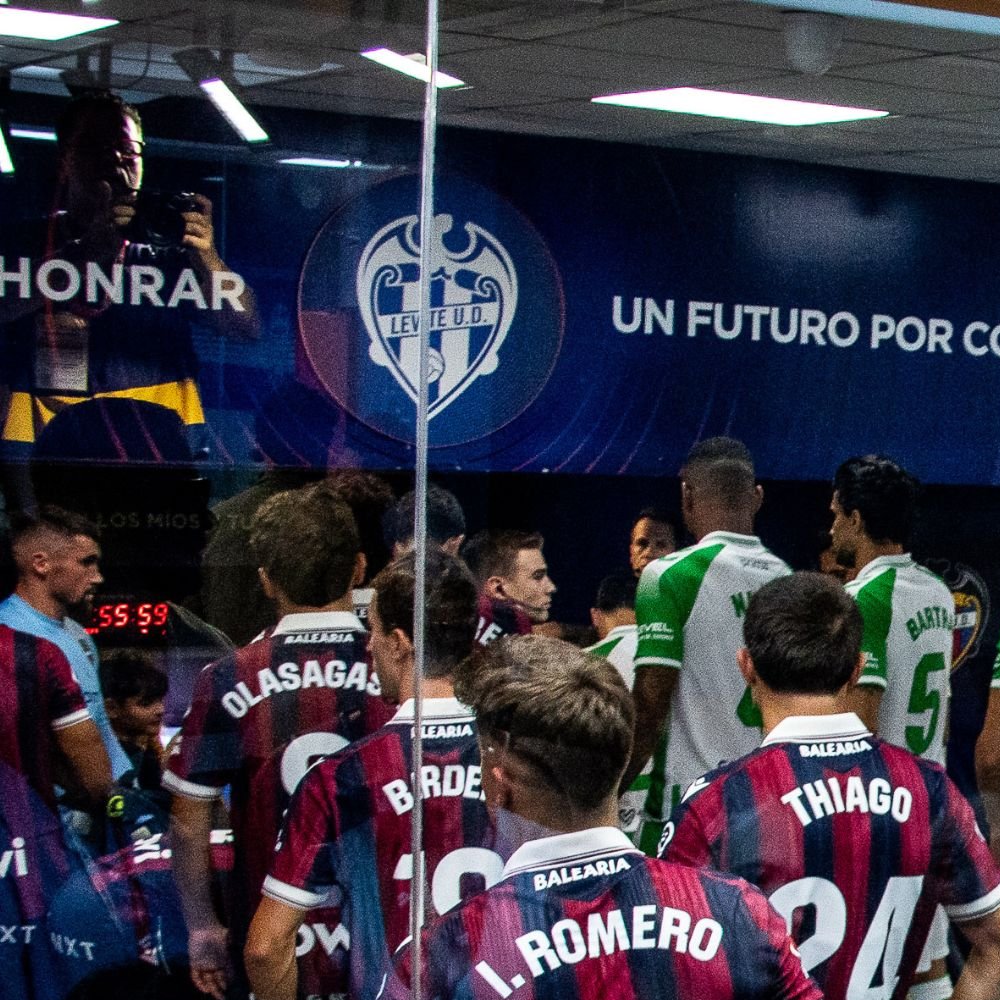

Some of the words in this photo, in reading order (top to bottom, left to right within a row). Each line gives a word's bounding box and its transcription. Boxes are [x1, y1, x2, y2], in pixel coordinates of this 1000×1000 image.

[0, 255, 246, 312] HONRAR
[391, 310, 447, 335] LEVTE
[612, 295, 674, 336] UN
[687, 301, 860, 348] FUTURO
[870, 314, 953, 353] POR
[905, 652, 945, 755] 5
[781, 776, 912, 826] THIAGO
[475, 960, 525, 999] I.
[515, 905, 723, 978] ROMERO
